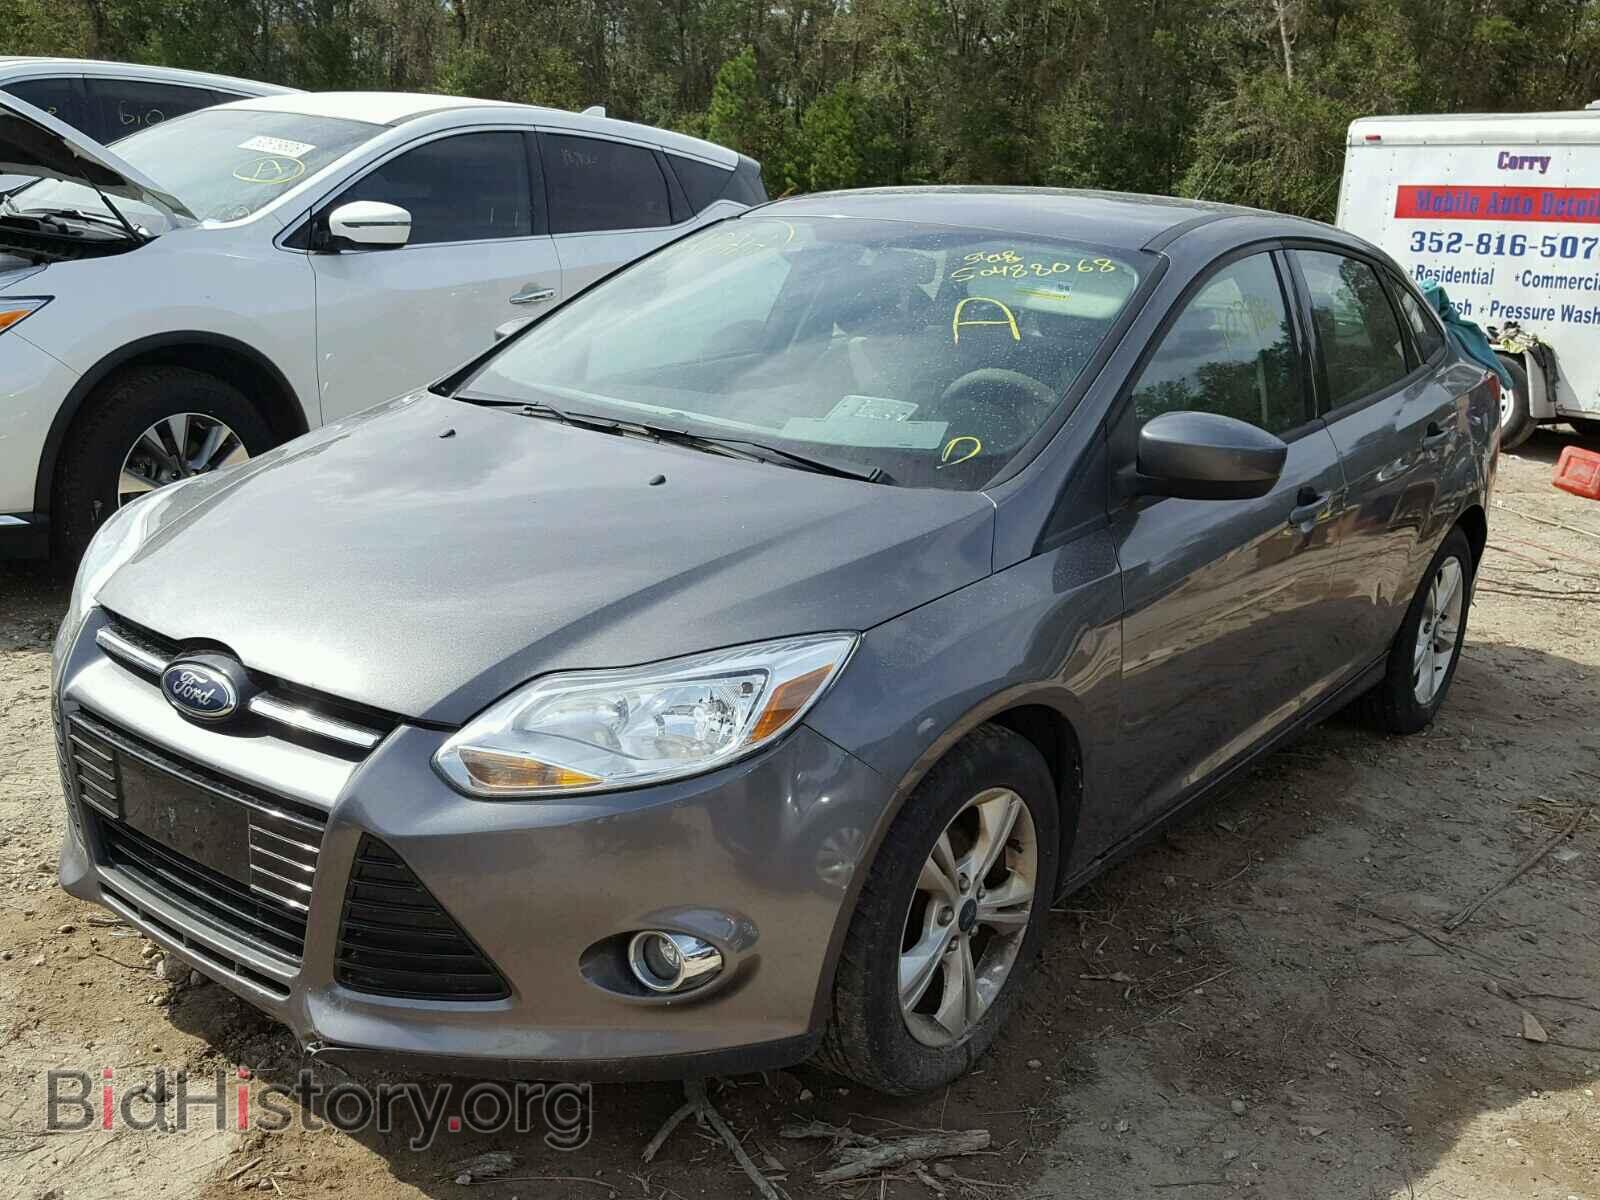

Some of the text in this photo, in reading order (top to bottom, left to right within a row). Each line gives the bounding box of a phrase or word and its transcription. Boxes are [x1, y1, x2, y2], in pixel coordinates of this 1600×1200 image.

[1497, 151, 1551, 175] Corry
[1413, 190, 1480, 214] Mobile
[1487, 191, 1532, 215] Auto
[1415, 264, 1600, 291] Residential Commerci
[1490, 300, 1556, 321] Pressure
[172, 671, 217, 706] Ford
